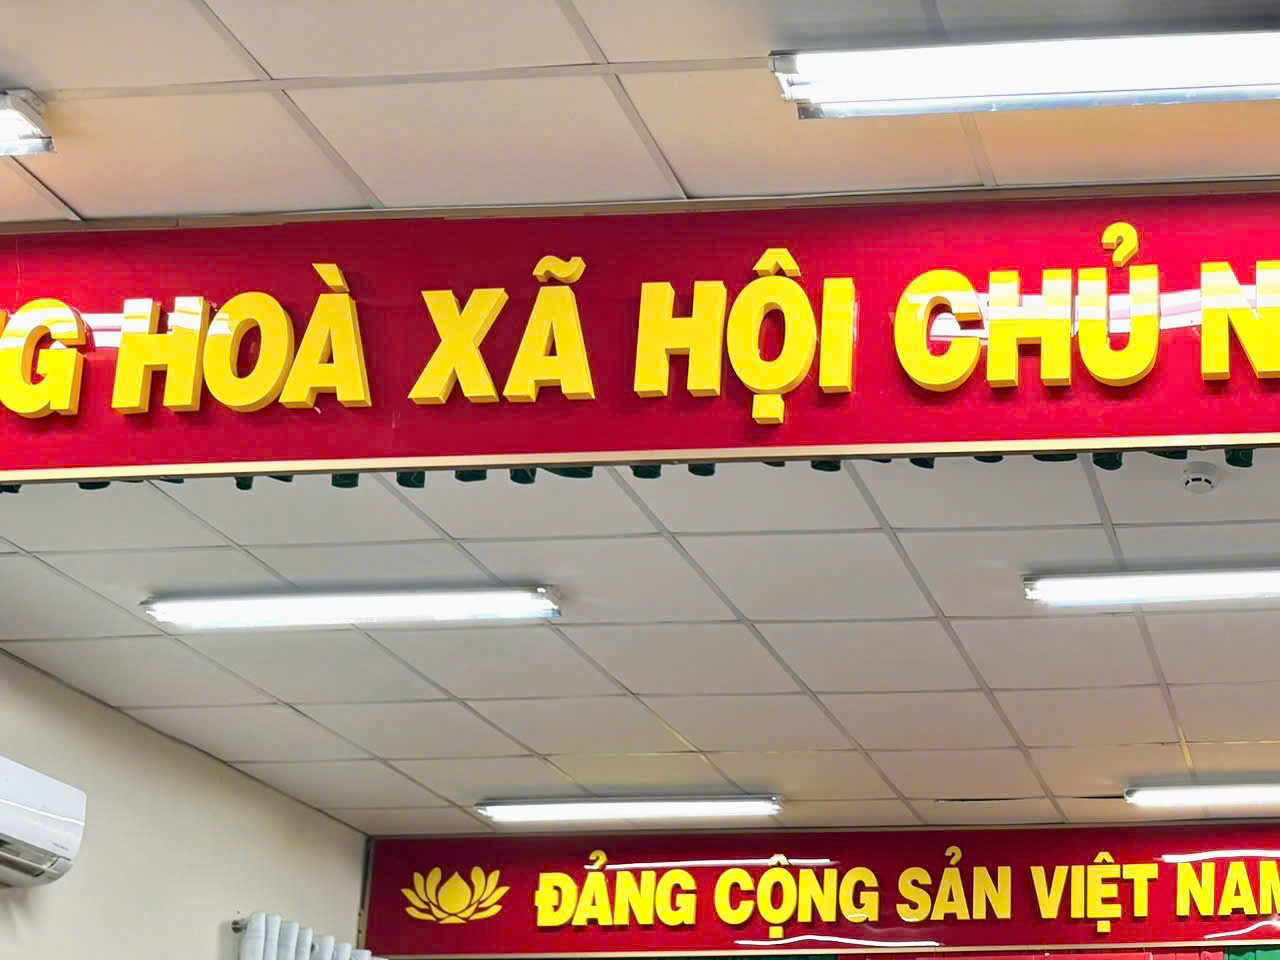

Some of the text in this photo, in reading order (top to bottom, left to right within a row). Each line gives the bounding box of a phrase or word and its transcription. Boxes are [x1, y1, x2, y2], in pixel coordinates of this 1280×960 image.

[111, 263, 372, 414] HOÀ
[408, 255, 595, 404] XÃ
[634, 248, 854, 424] HỘI
[894, 222, 1160, 391] CHỦ
[535, 850, 696, 927] ĐẢNG
[715, 853, 879, 938] CỘNG
[896, 846, 1012, 922] SẢN
[1030, 852, 1158, 933] VIỆT
